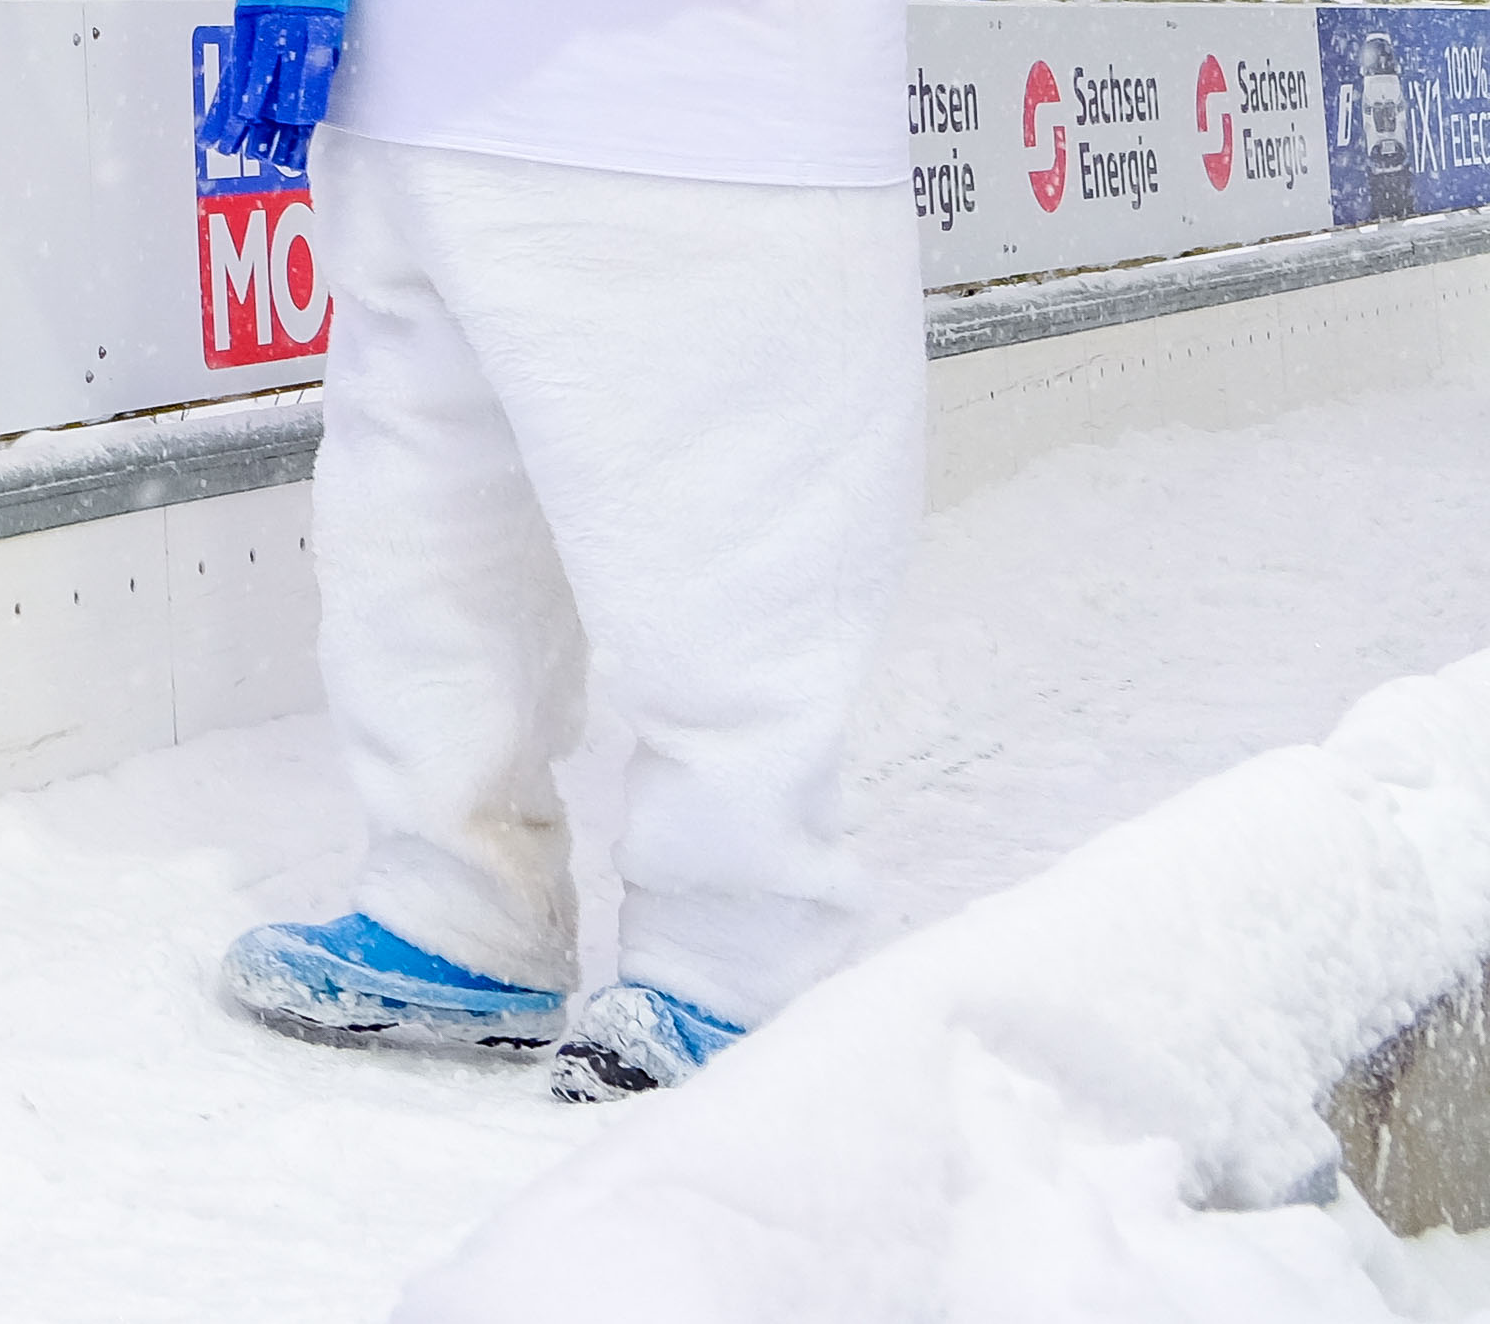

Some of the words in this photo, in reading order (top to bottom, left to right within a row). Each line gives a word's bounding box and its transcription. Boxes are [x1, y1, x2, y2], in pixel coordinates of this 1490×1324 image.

[908, 68, 979, 134] chsen
[1073, 66, 1159, 126] Sachsen
[1237, 58, 1308, 113] Sachsen
[1242, 127, 1308, 190] Energie
[1408, 78, 1446, 173] iX1
[913, 149, 977, 233] ergie
[1079, 136, 1159, 210] Energie
[207, 201, 332, 351] MO
